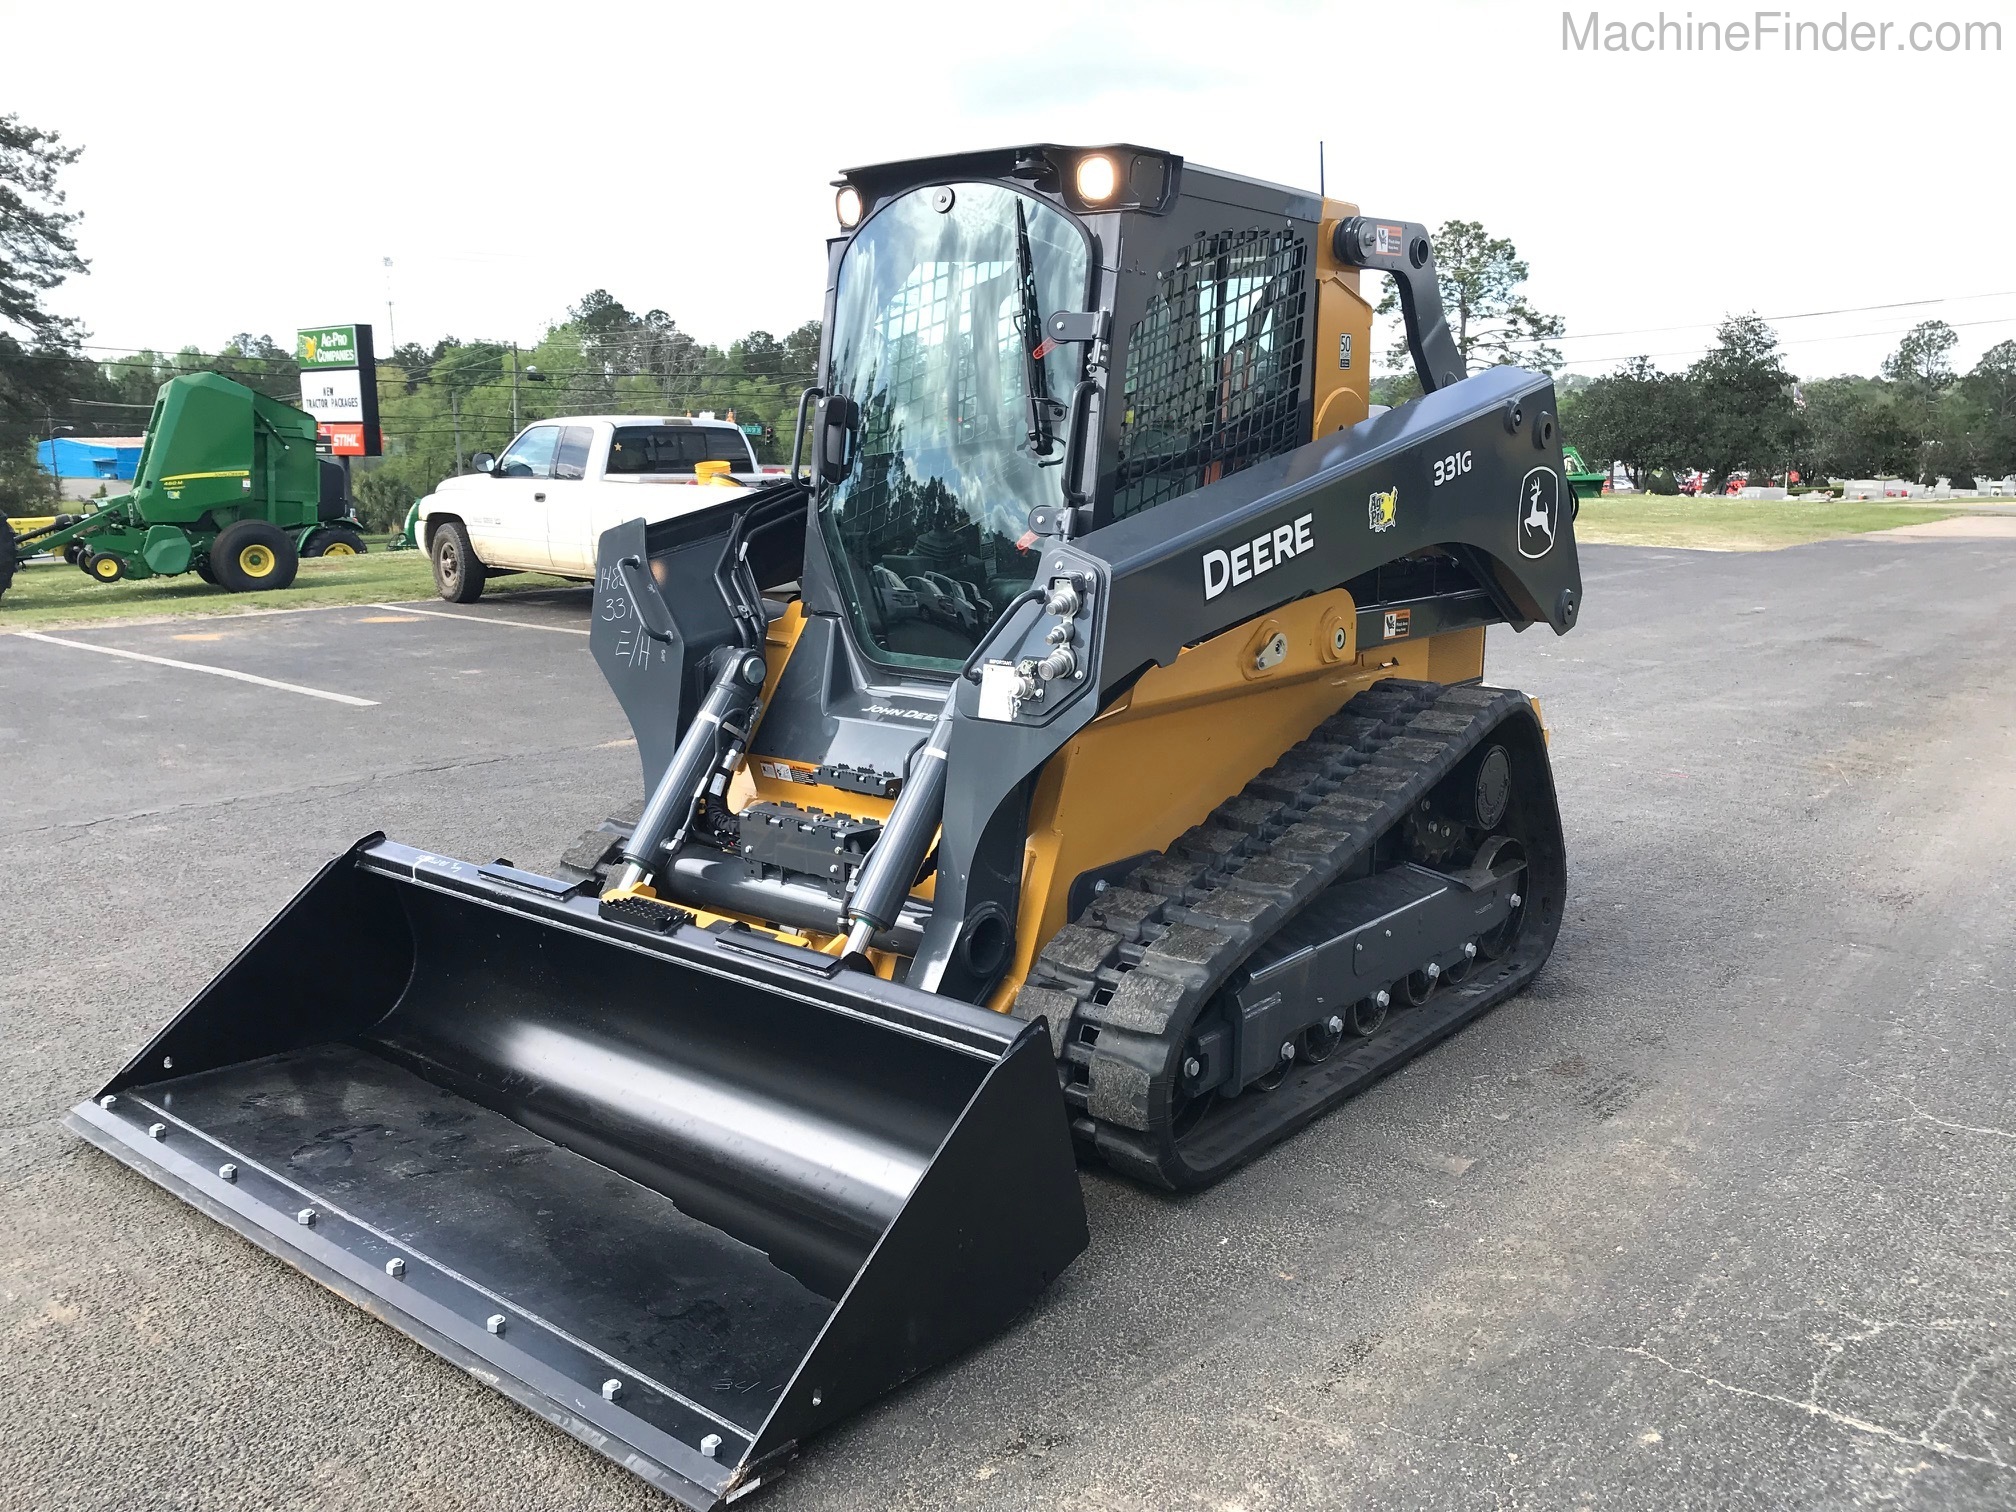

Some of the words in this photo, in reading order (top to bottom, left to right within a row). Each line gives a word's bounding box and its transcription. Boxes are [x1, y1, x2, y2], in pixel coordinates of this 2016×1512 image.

[323, 387, 333, 396] NEW
[306, 398, 328, 408] TRACTOR
[331, 397, 358, 407] PACKAGES
[333, 433, 359, 447] STIHL
[1433, 450, 1472, 486] 331G
[1202, 512, 1315, 601] DEERE
[861, 704, 905, 717] JOHN
